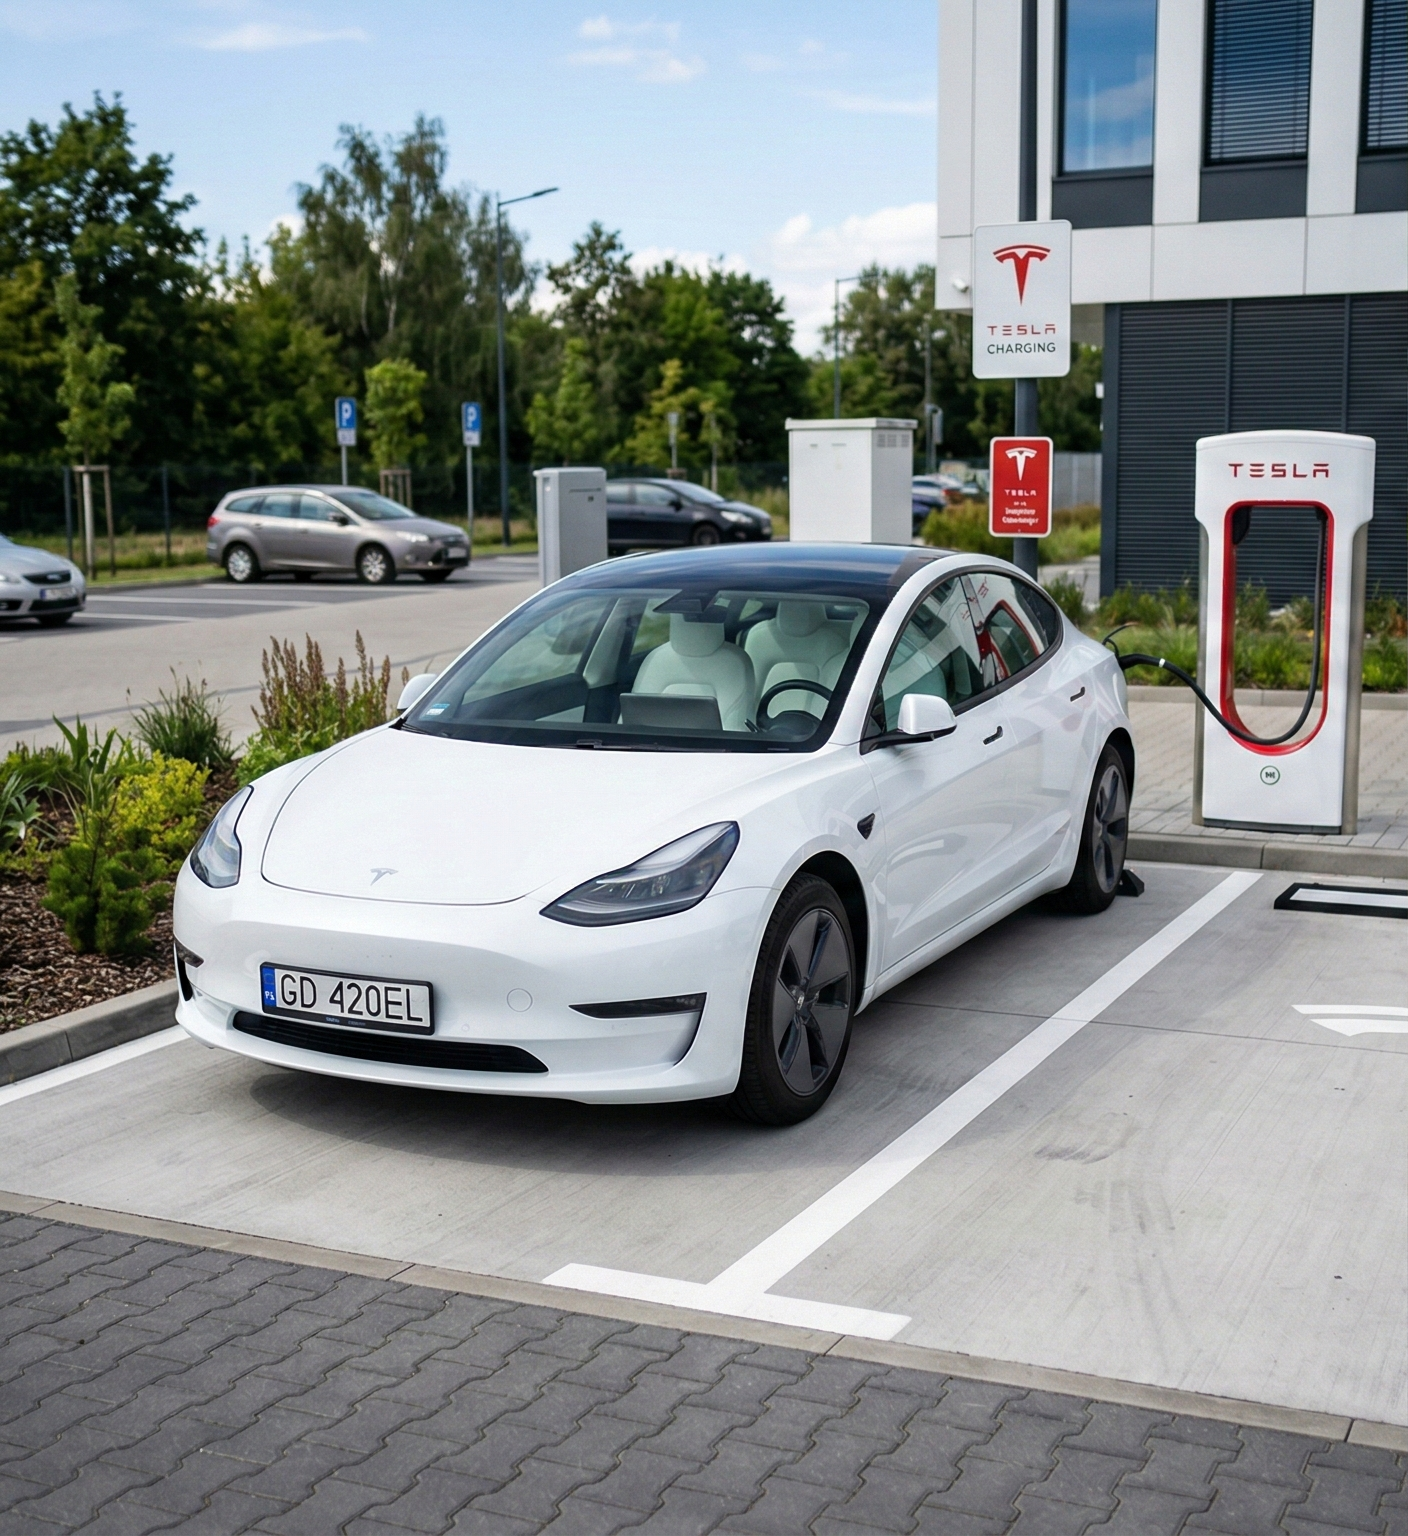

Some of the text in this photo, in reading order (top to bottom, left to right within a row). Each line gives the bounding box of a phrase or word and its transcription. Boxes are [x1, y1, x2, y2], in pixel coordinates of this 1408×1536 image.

[987, 324, 1056, 336] TESLA
[987, 342, 1056, 355] CHARGING
[341, 401, 353, 427] P
[466, 405, 478, 429] P
[1228, 463, 1329, 478] TESLA
[280, 973, 423, 1022] GD 420EL
